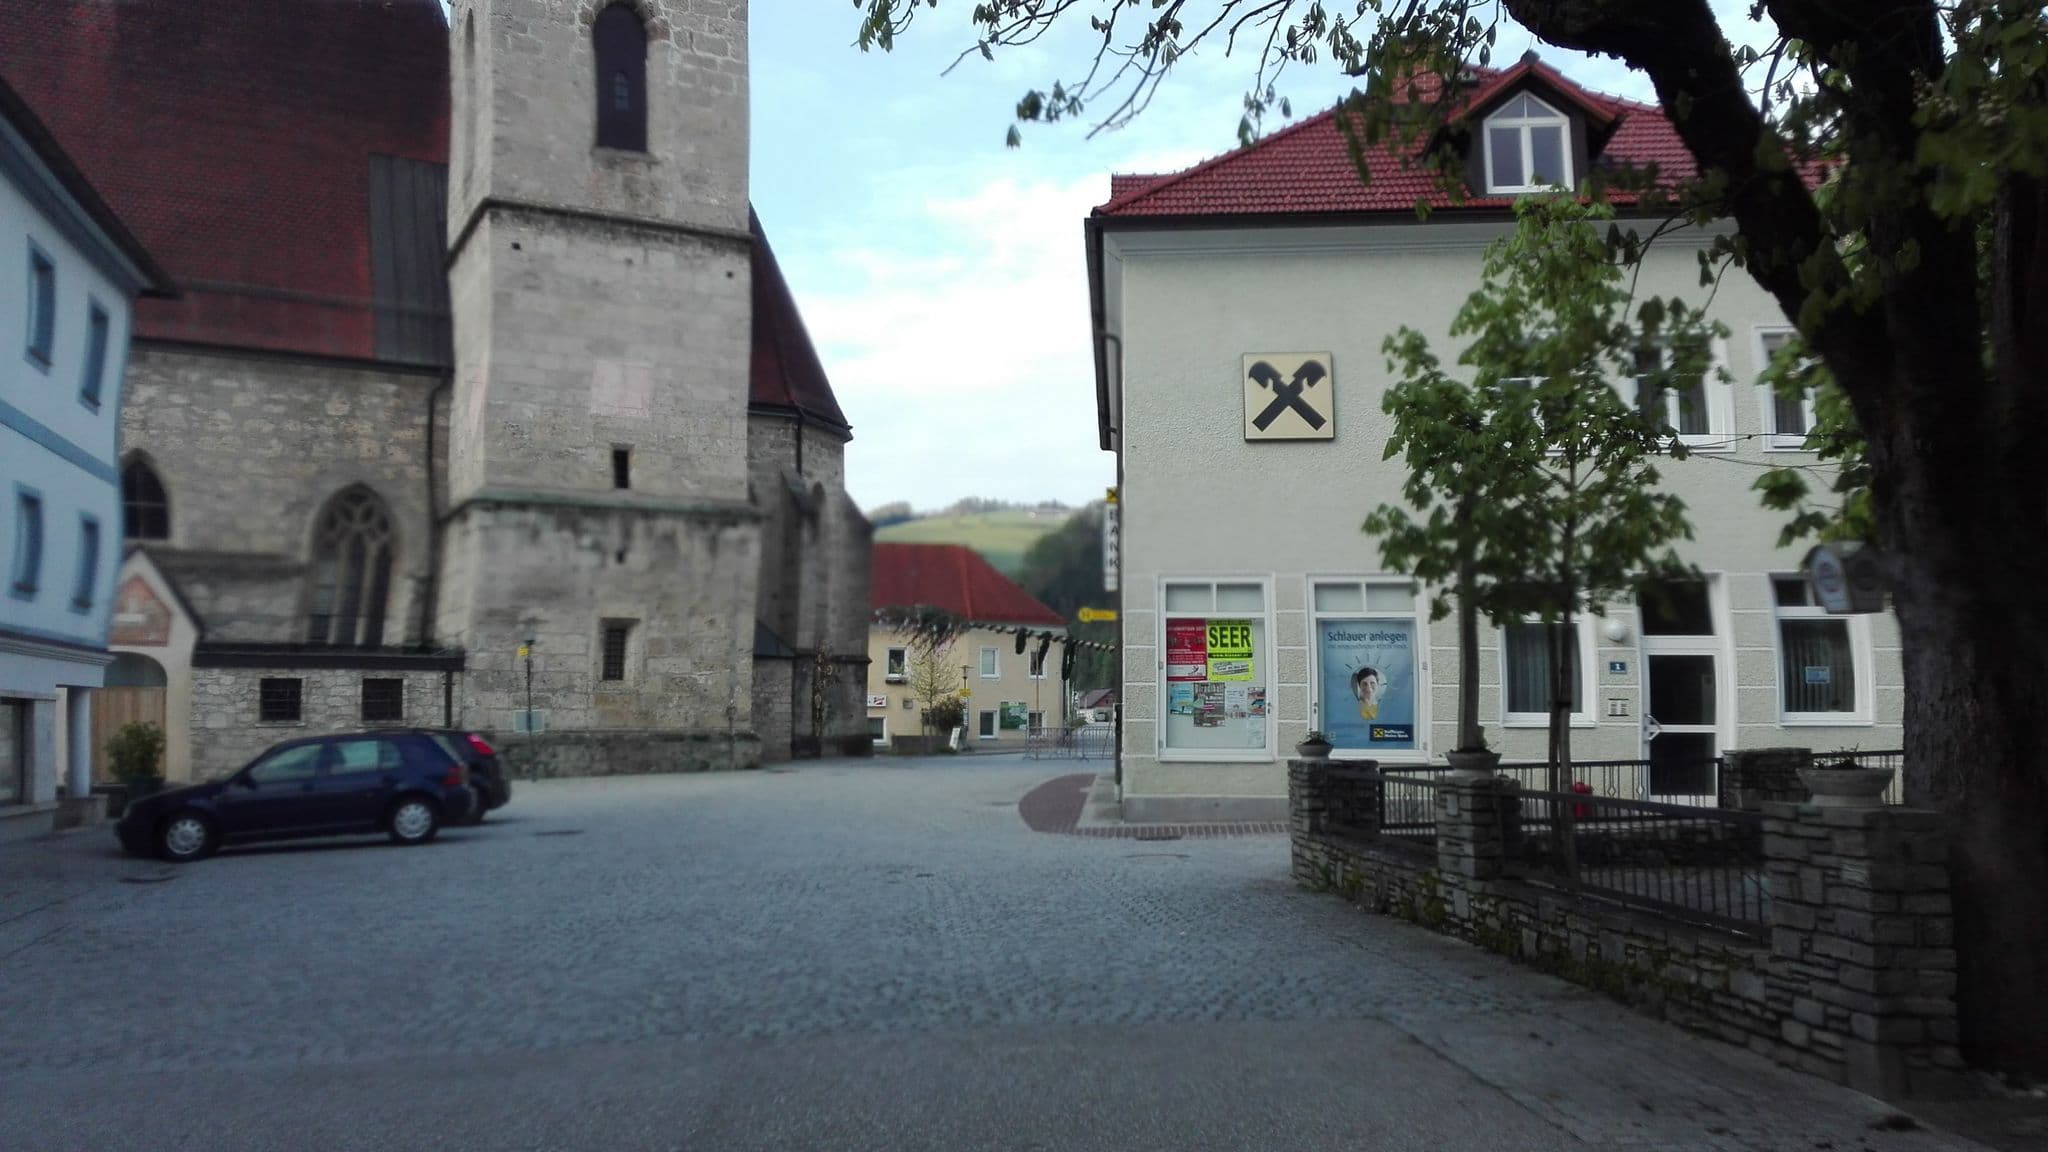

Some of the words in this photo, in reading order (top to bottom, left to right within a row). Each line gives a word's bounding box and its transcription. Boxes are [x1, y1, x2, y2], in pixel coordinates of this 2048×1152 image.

[1208, 626, 1252, 648] SEER
[1327, 630, 1367, 641] Schlauer
[1369, 630, 1408, 644] anlegen
